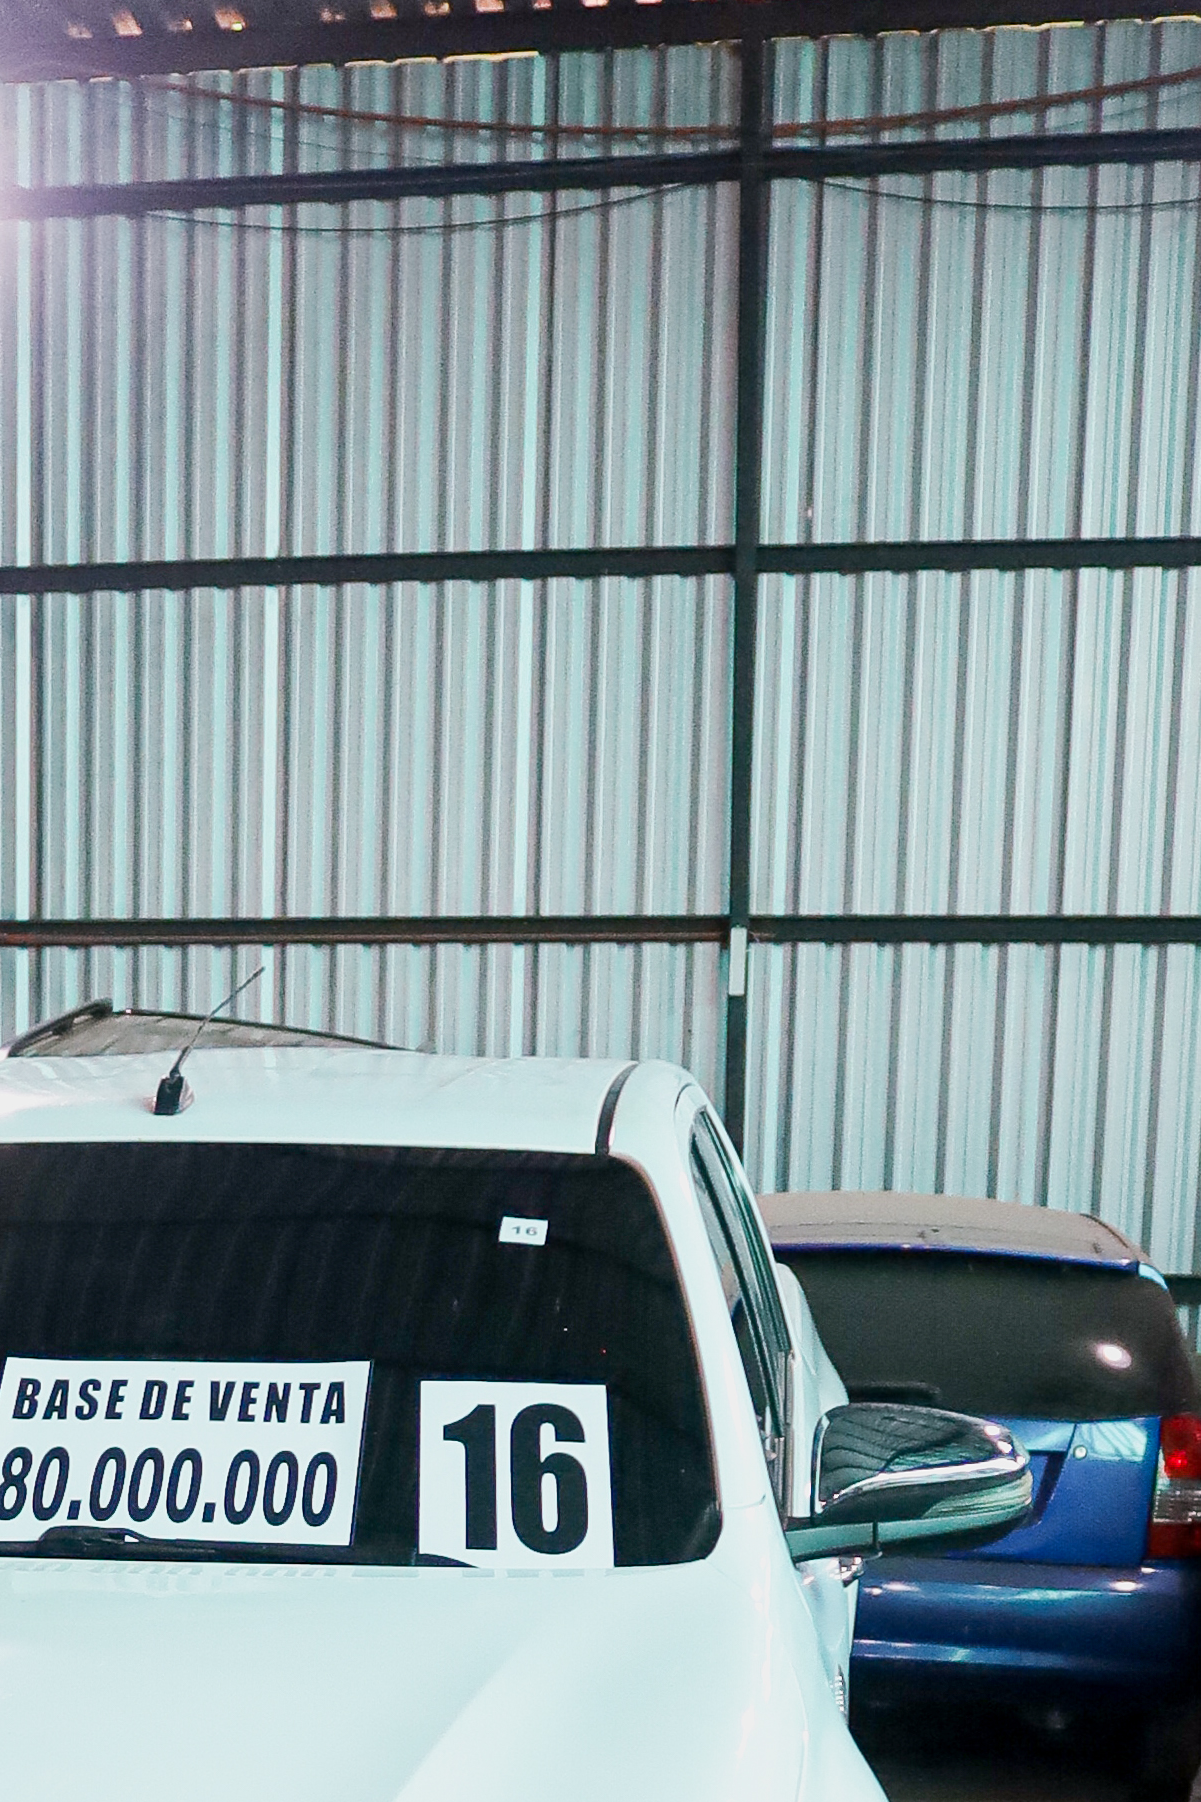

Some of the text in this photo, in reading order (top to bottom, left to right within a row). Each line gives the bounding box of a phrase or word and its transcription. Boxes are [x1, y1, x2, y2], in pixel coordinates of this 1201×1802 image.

[511, 1225, 538, 1237] 16
[11, 1377, 347, 1425] BASE DE VENTA
[441, 1402, 590, 1556] 16
